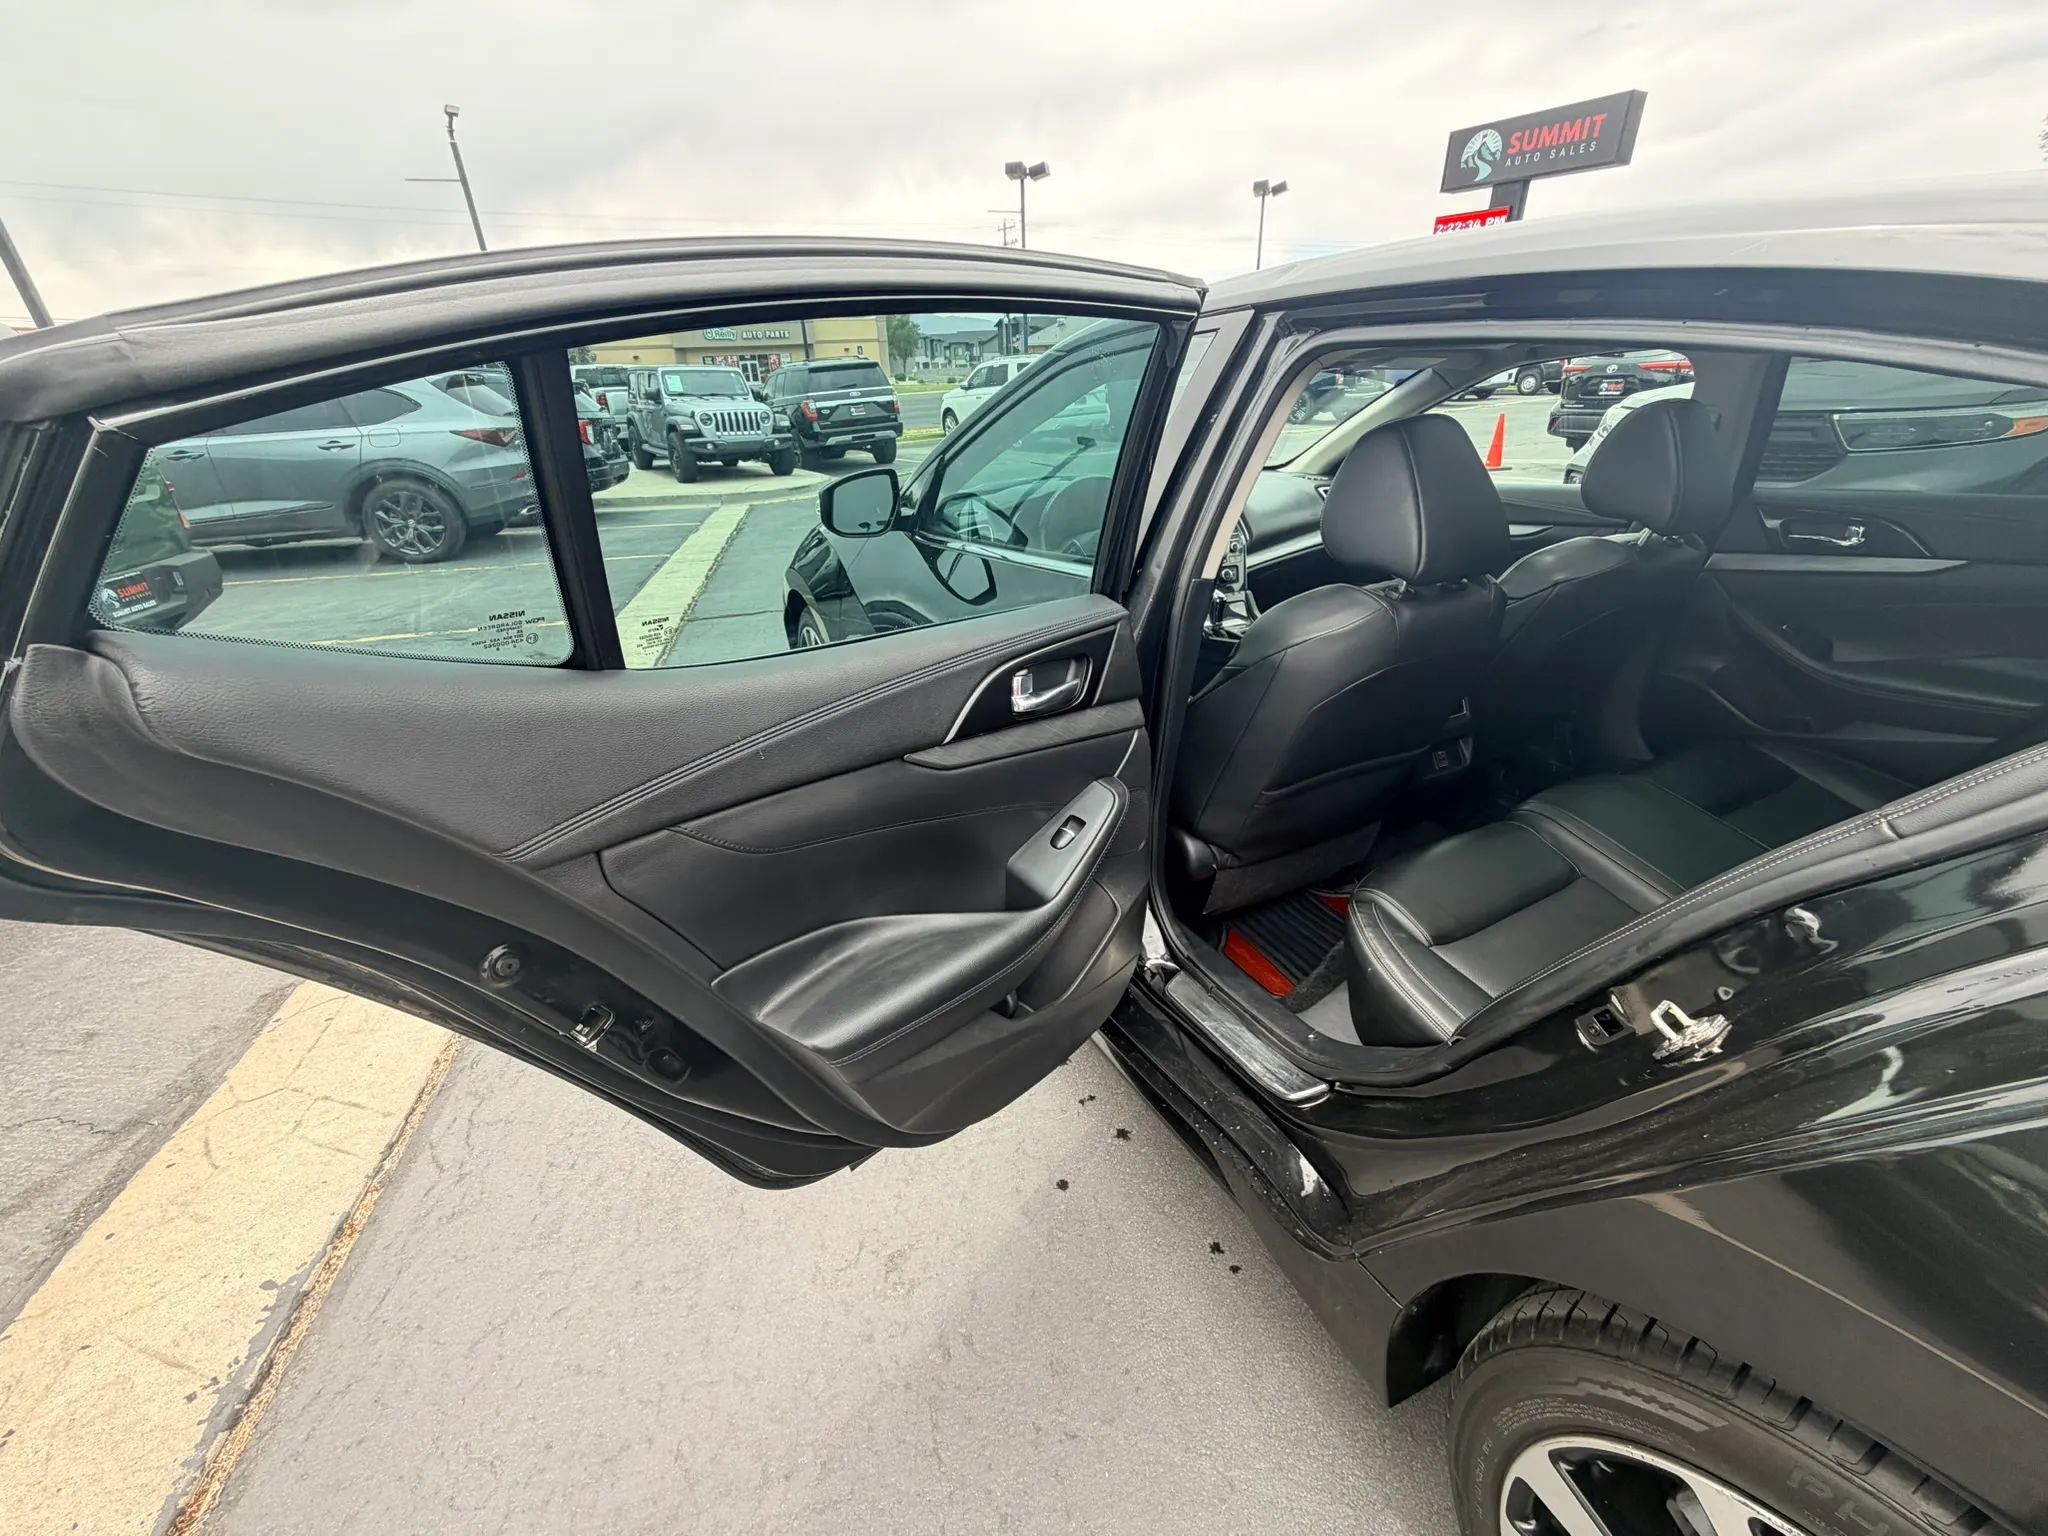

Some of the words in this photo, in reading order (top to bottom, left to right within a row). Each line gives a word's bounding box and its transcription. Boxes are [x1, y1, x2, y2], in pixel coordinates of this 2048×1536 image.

[1507, 113, 1607, 155] SUMMIT
[1505, 152, 1540, 167] AUTO
[1549, 141, 1597, 159] SALES
[1486, 215, 1507, 227] PM
[742, 330, 763, 340] AUTO
[765, 329, 789, 340] PARTS
[117, 581, 150, 598] SUMMIT
